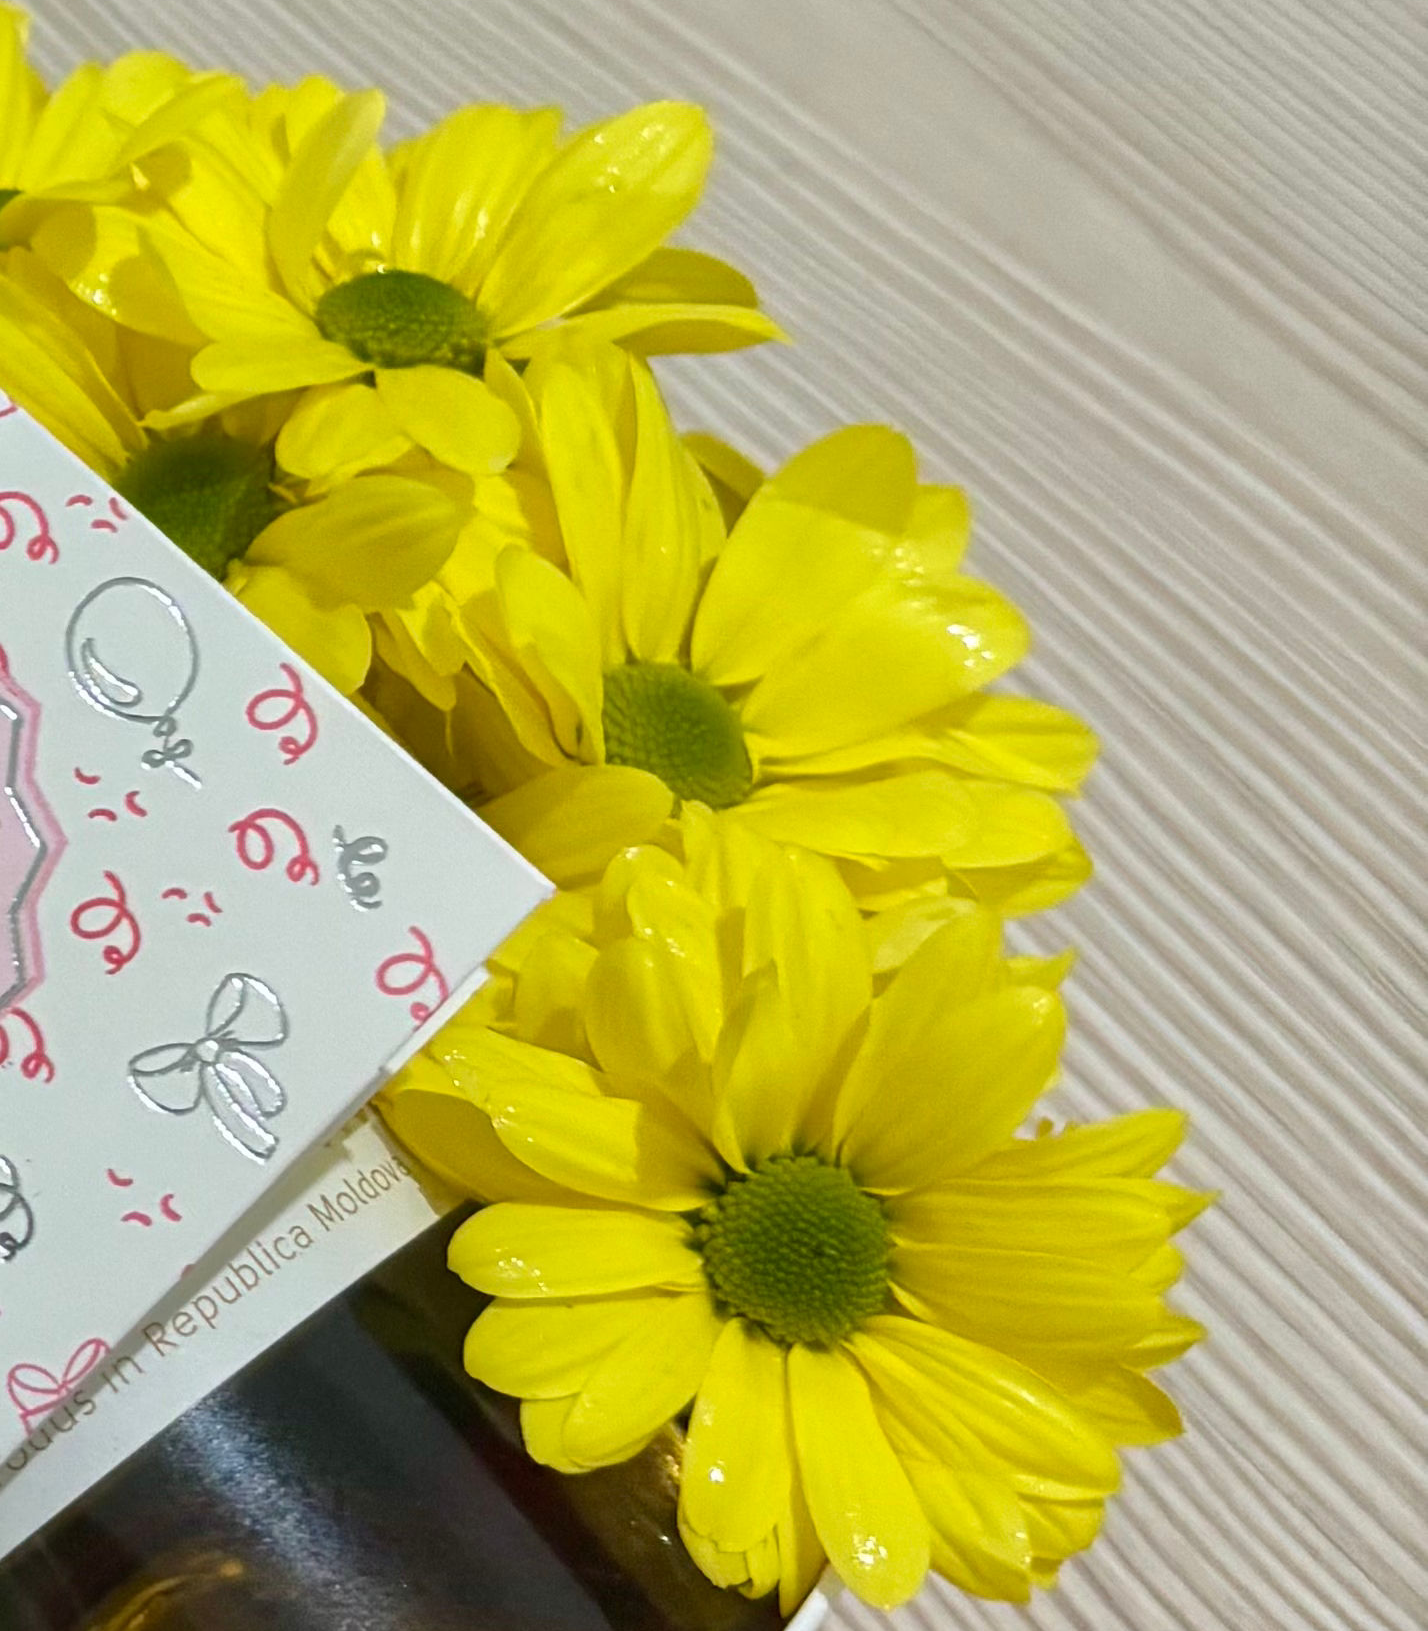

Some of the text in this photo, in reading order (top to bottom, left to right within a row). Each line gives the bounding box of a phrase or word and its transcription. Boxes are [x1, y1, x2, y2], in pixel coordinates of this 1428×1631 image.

[101, 1355, 145, 1394] in
[142, 1224, 314, 1358] Republica
[306, 1155, 410, 1233] Moldova
